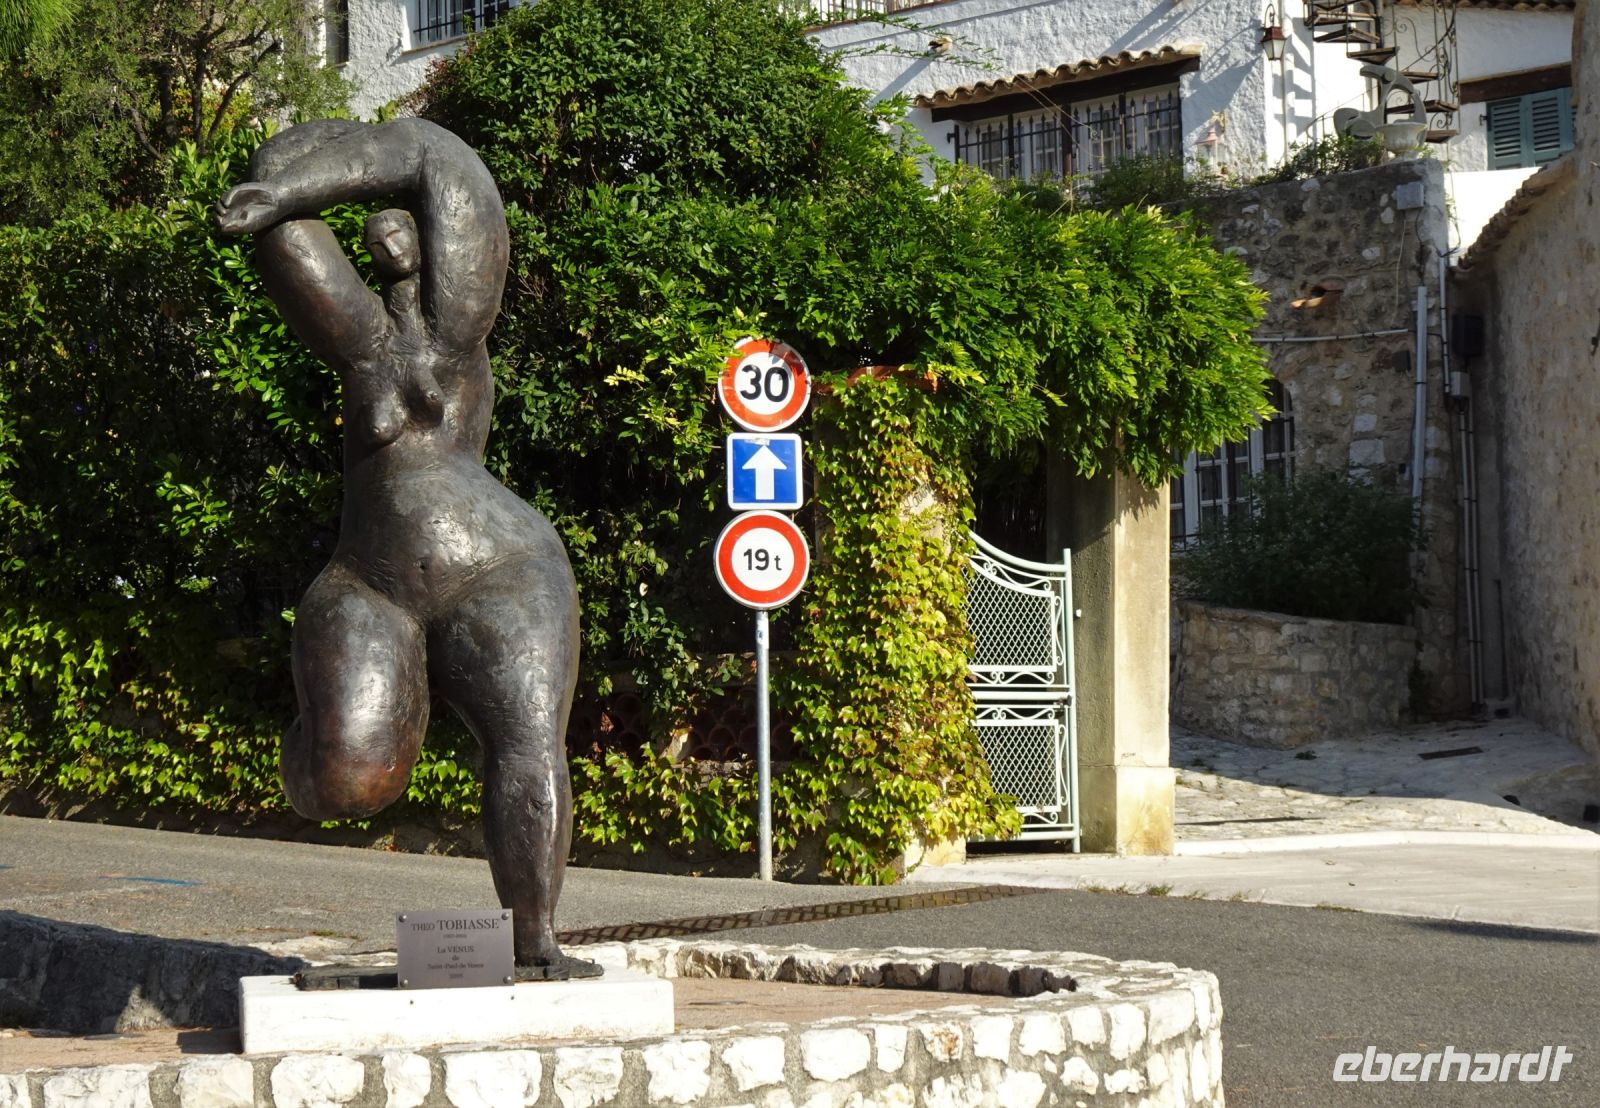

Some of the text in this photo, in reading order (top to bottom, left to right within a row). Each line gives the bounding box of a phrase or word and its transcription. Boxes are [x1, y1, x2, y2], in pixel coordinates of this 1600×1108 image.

[740, 364, 790, 403] 30
[743, 548, 782, 571] 19 t
[437, 918, 500, 931] TOBIASSE
